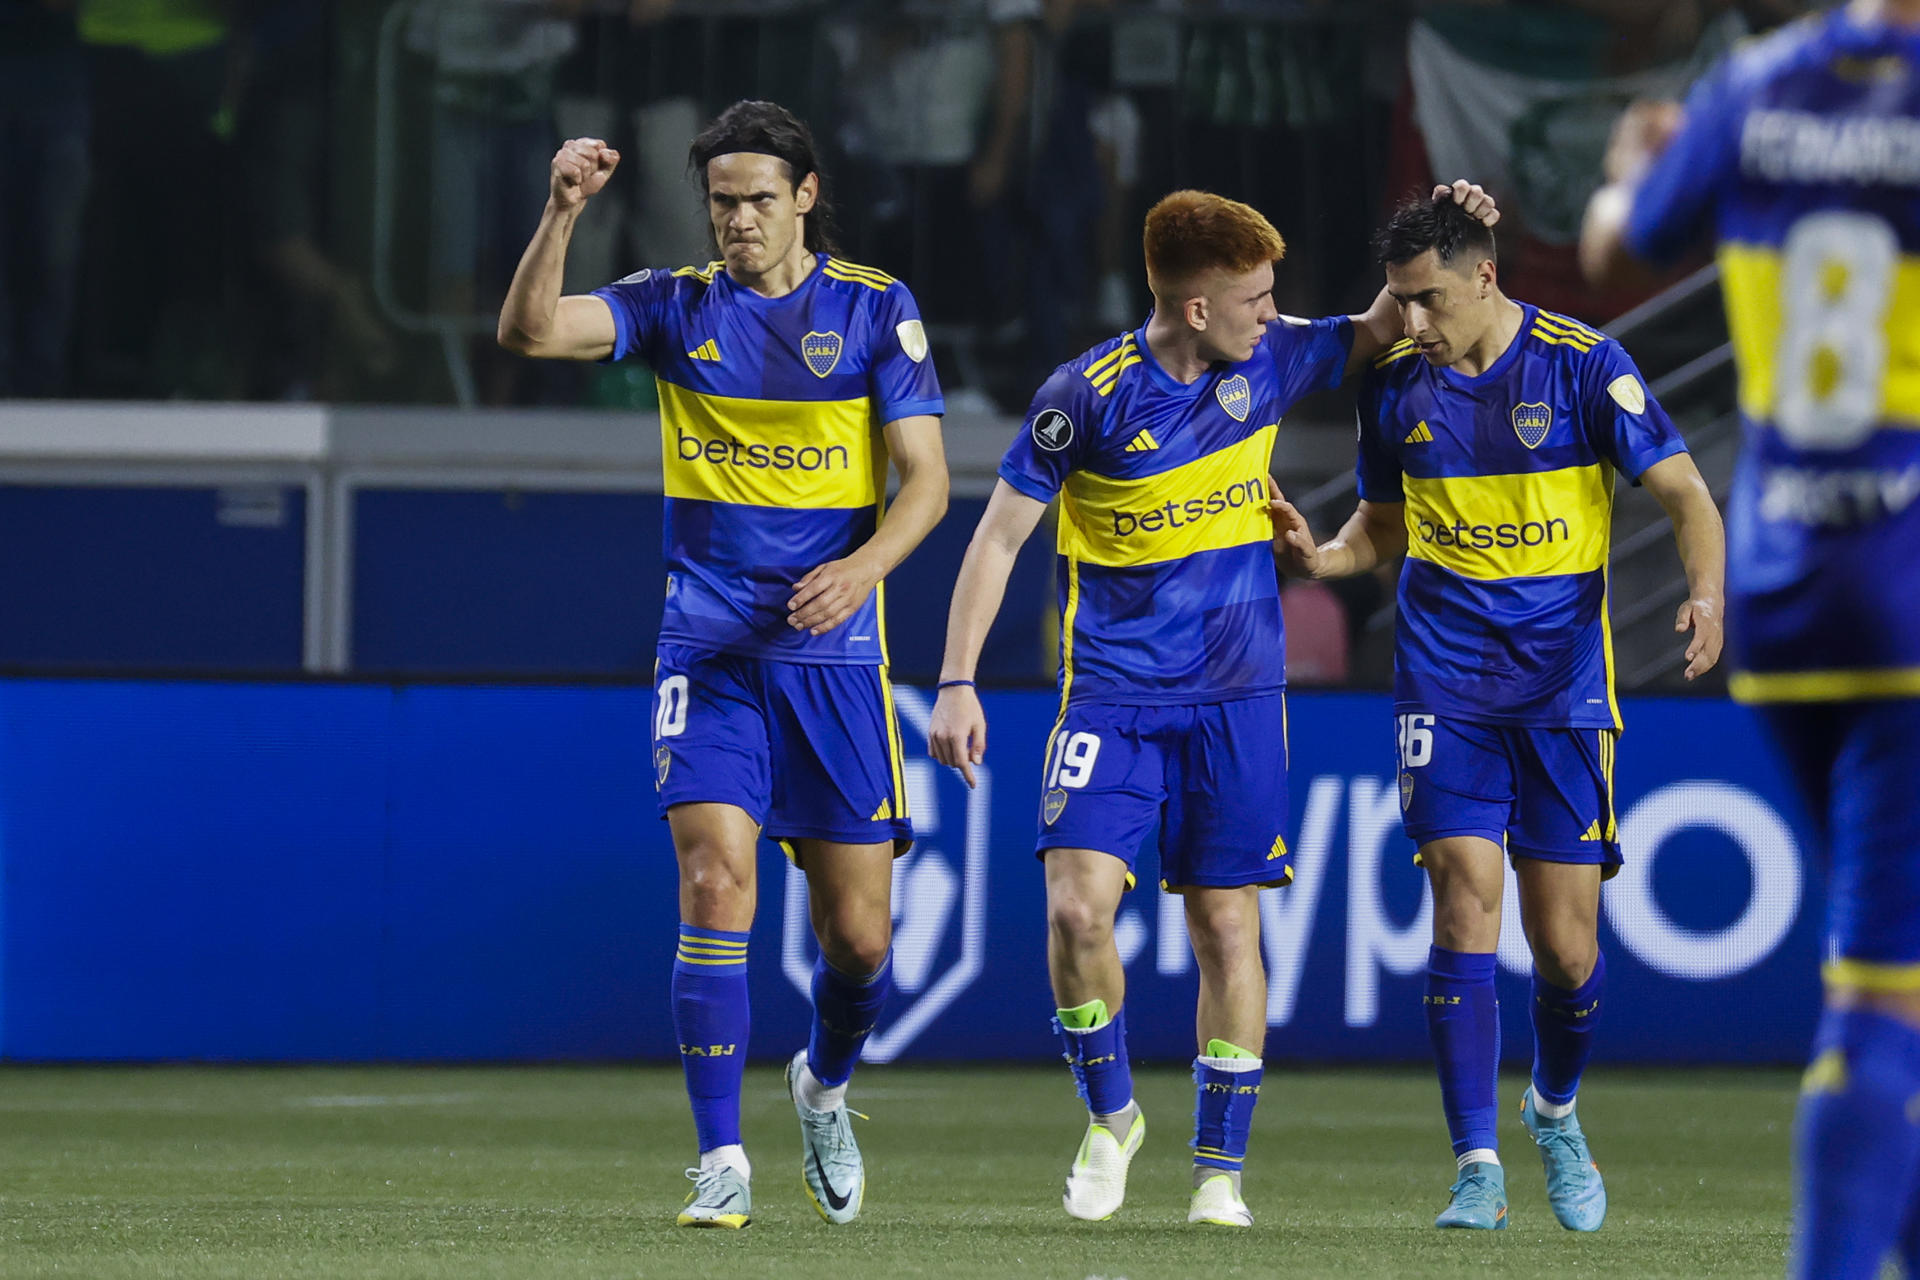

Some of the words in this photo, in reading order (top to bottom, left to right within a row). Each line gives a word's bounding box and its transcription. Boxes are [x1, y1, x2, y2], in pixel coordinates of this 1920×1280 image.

[807, 346, 837, 356] CABJ
[1775, 210, 1898, 449] 8
[1222, 389, 1247, 404] CABJ
[1517, 418, 1545, 427] CABJ
[677, 427, 848, 472] betsson
[1112, 477, 1264, 537] betsson
[1418, 517, 1568, 549] betsson
[655, 675, 688, 741] 10
[1048, 730, 1100, 789] 19
[1399, 713, 1435, 769] 16
[1115, 775, 1803, 1028] ypo
[680, 1044, 736, 1057] CABJ
